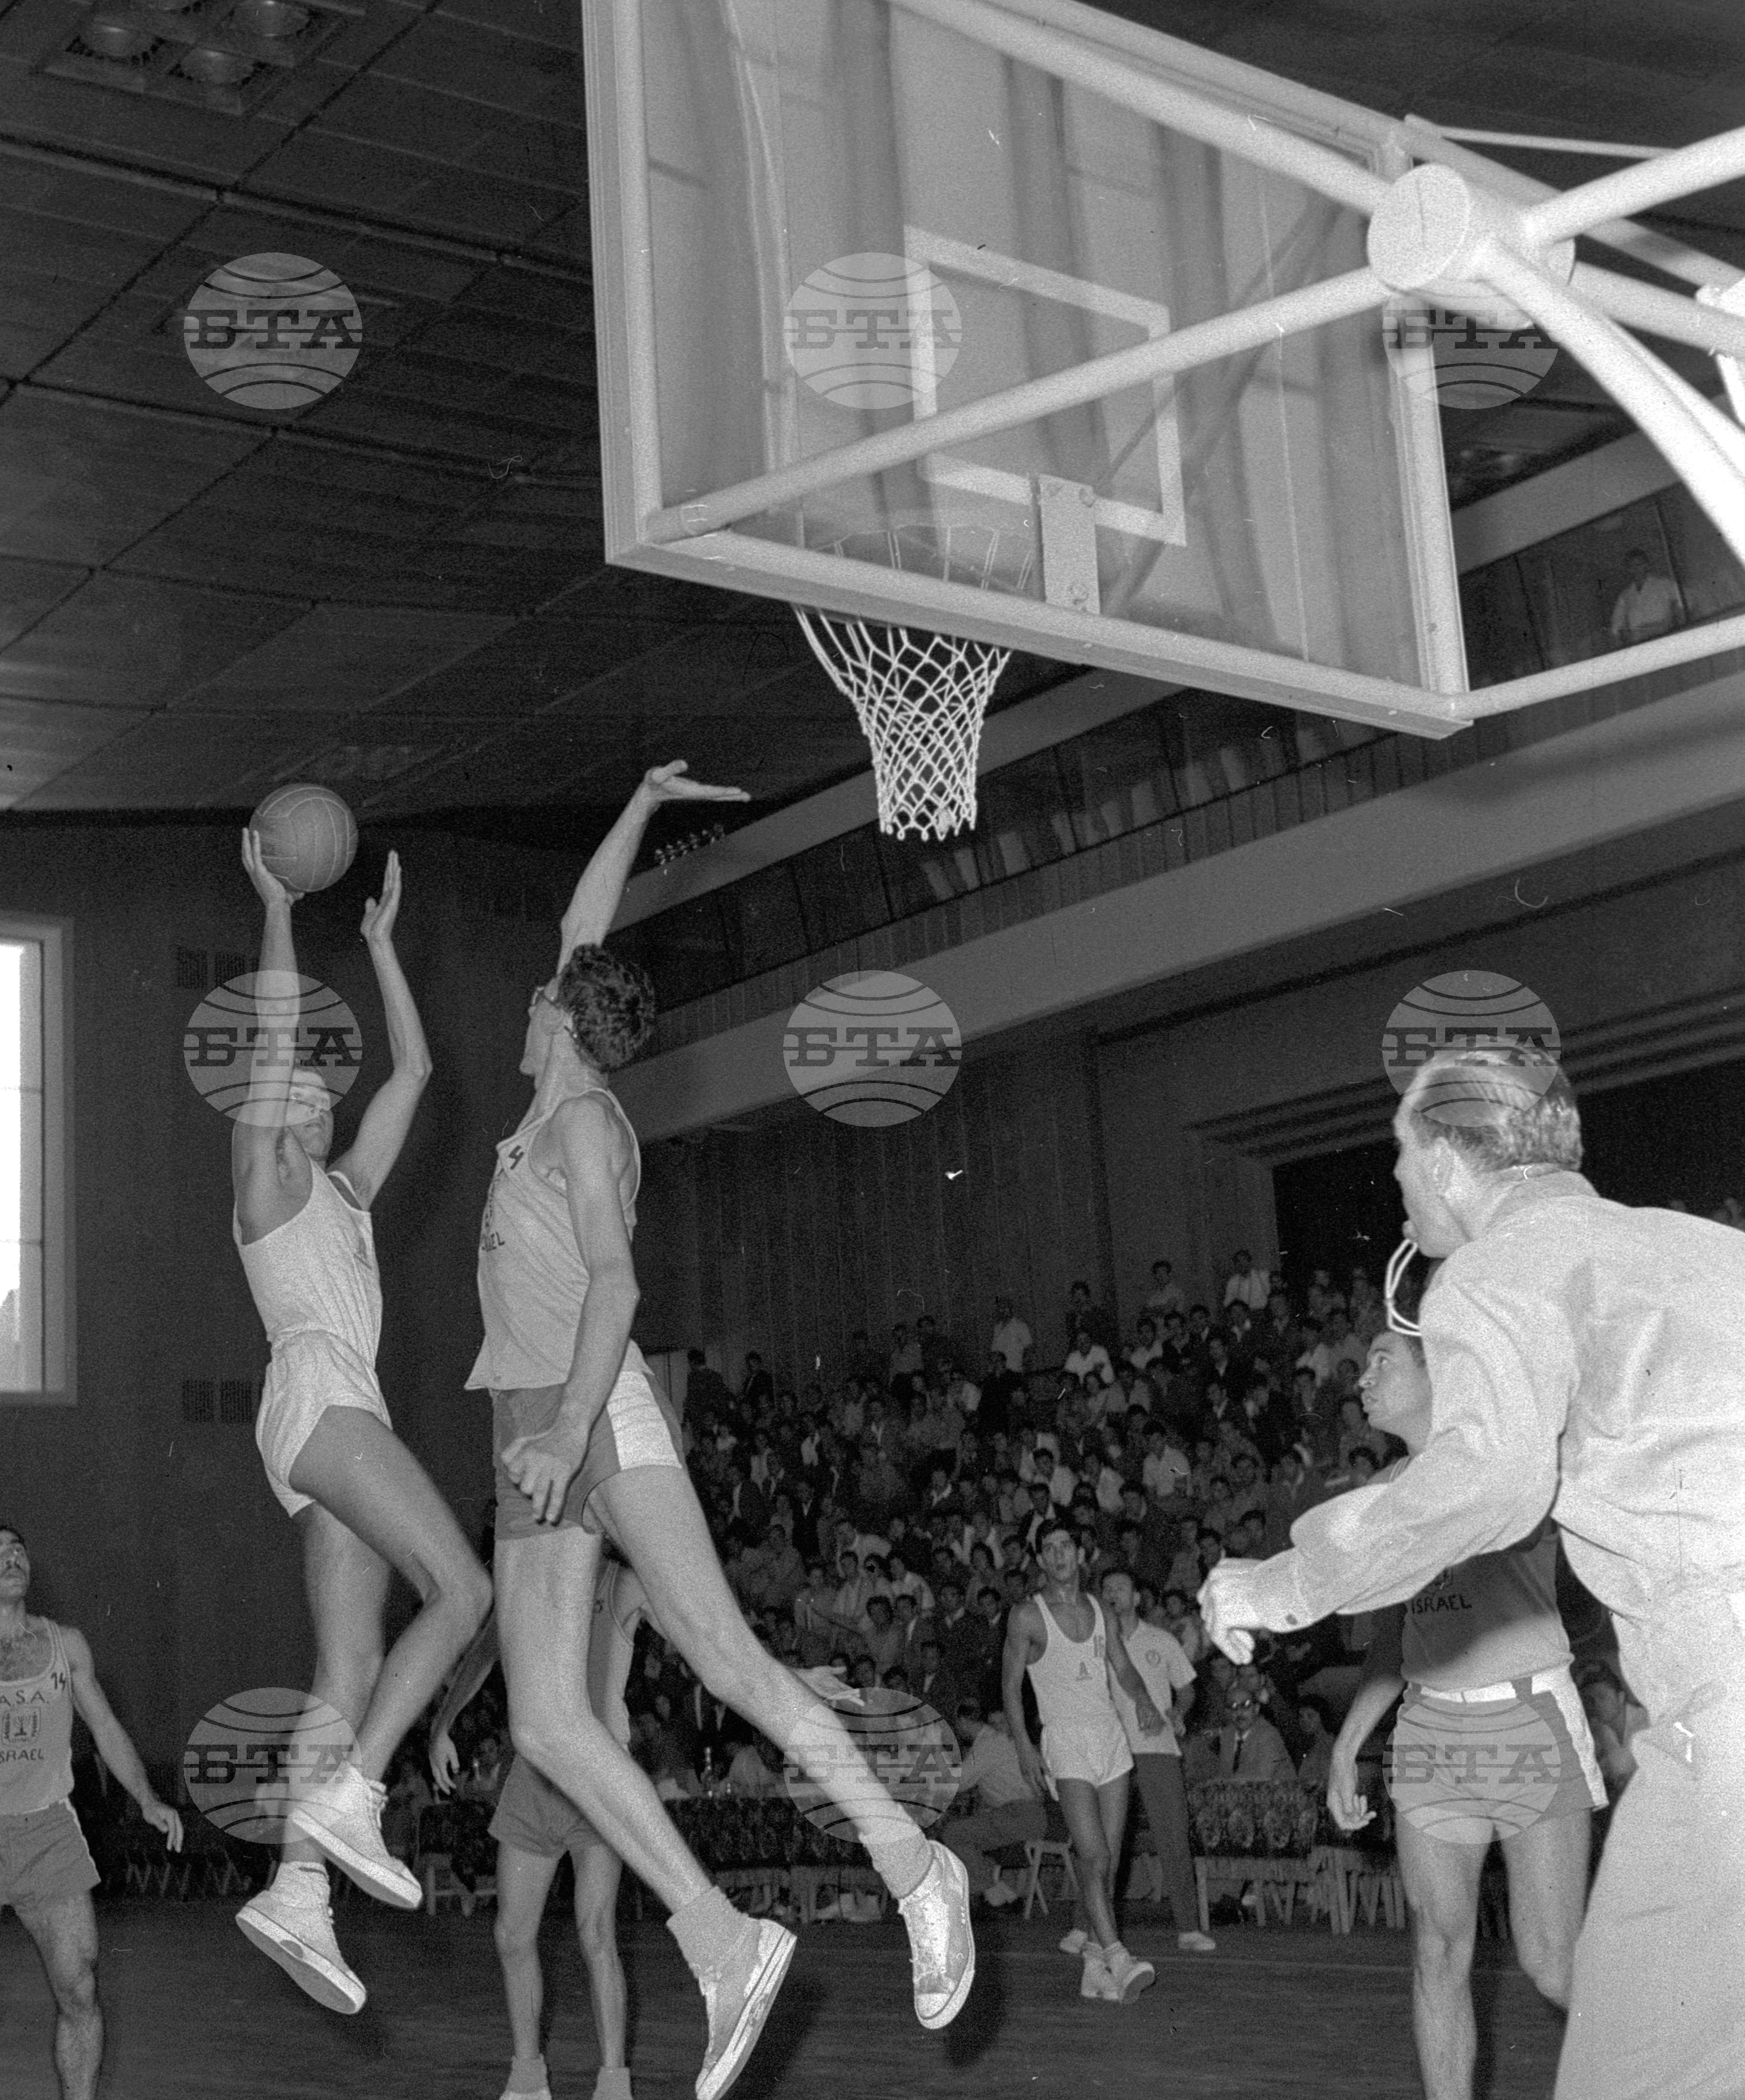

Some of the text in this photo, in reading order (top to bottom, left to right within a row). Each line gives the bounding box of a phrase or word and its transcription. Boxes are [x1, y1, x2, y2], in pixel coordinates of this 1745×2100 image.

[1411, 1594, 1472, 1614] ISRAEL
[51, 1672, 66, 1692] 14
[0, 1748, 44, 1765] SRAEL
